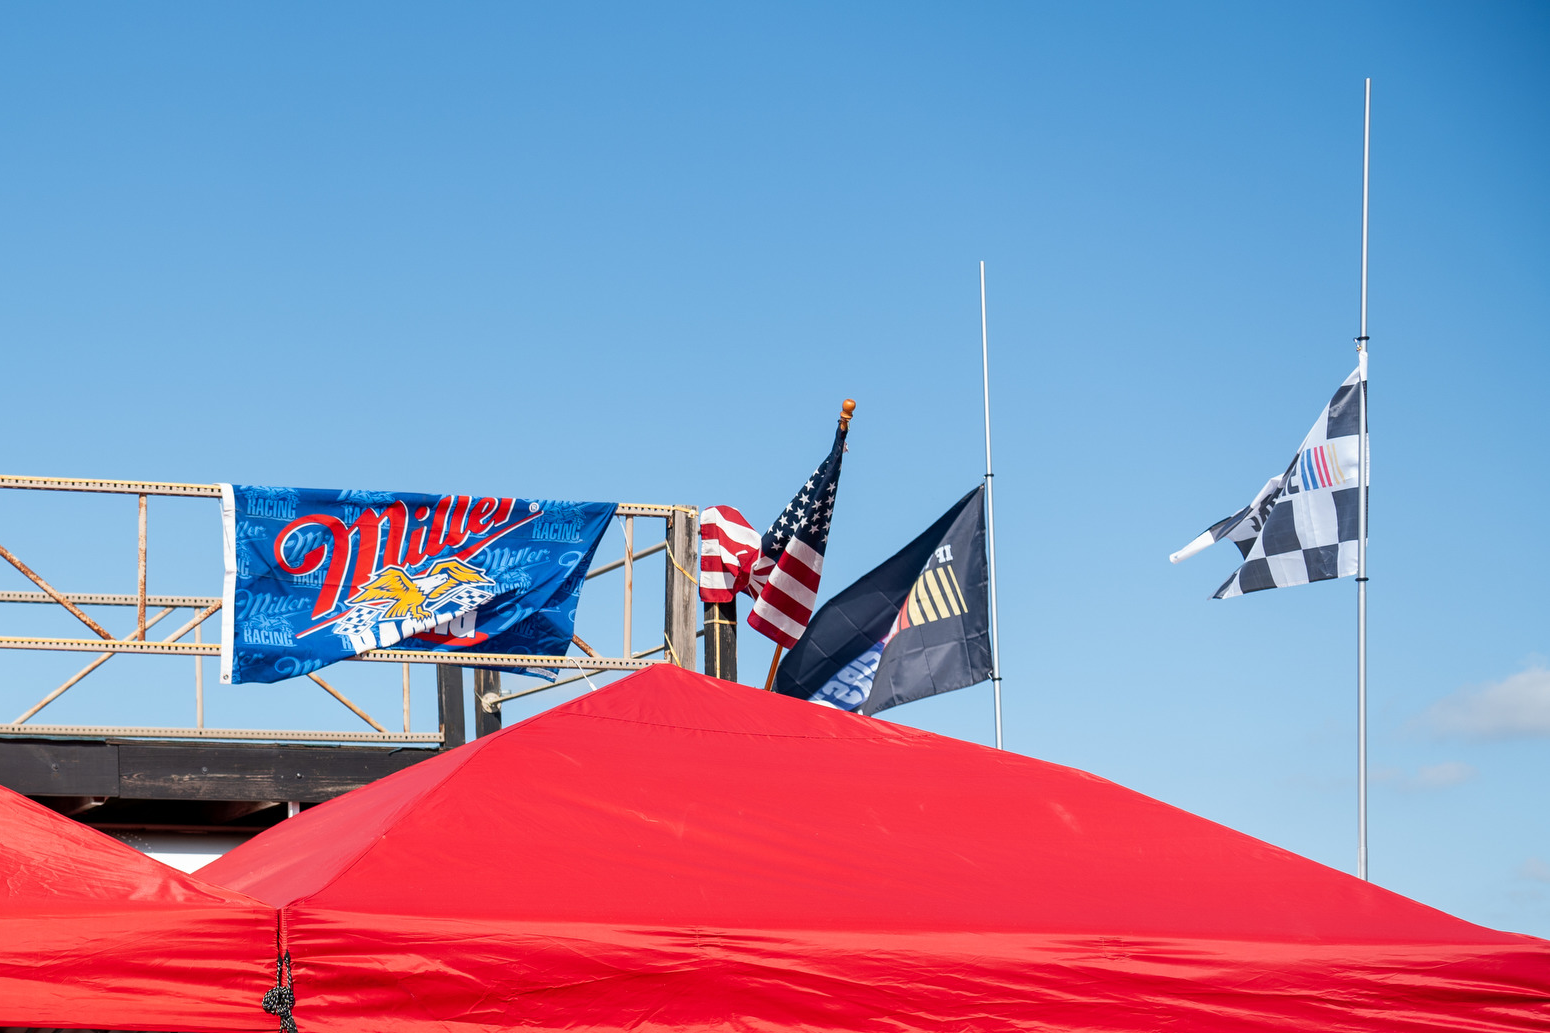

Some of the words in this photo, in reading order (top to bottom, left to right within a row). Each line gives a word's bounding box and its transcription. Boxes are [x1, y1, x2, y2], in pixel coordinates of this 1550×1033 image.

[246, 498, 297, 520] RACING
[531, 522, 581, 541] RACING
[274, 495, 516, 621] Miller
[243, 626, 293, 647] RACING
